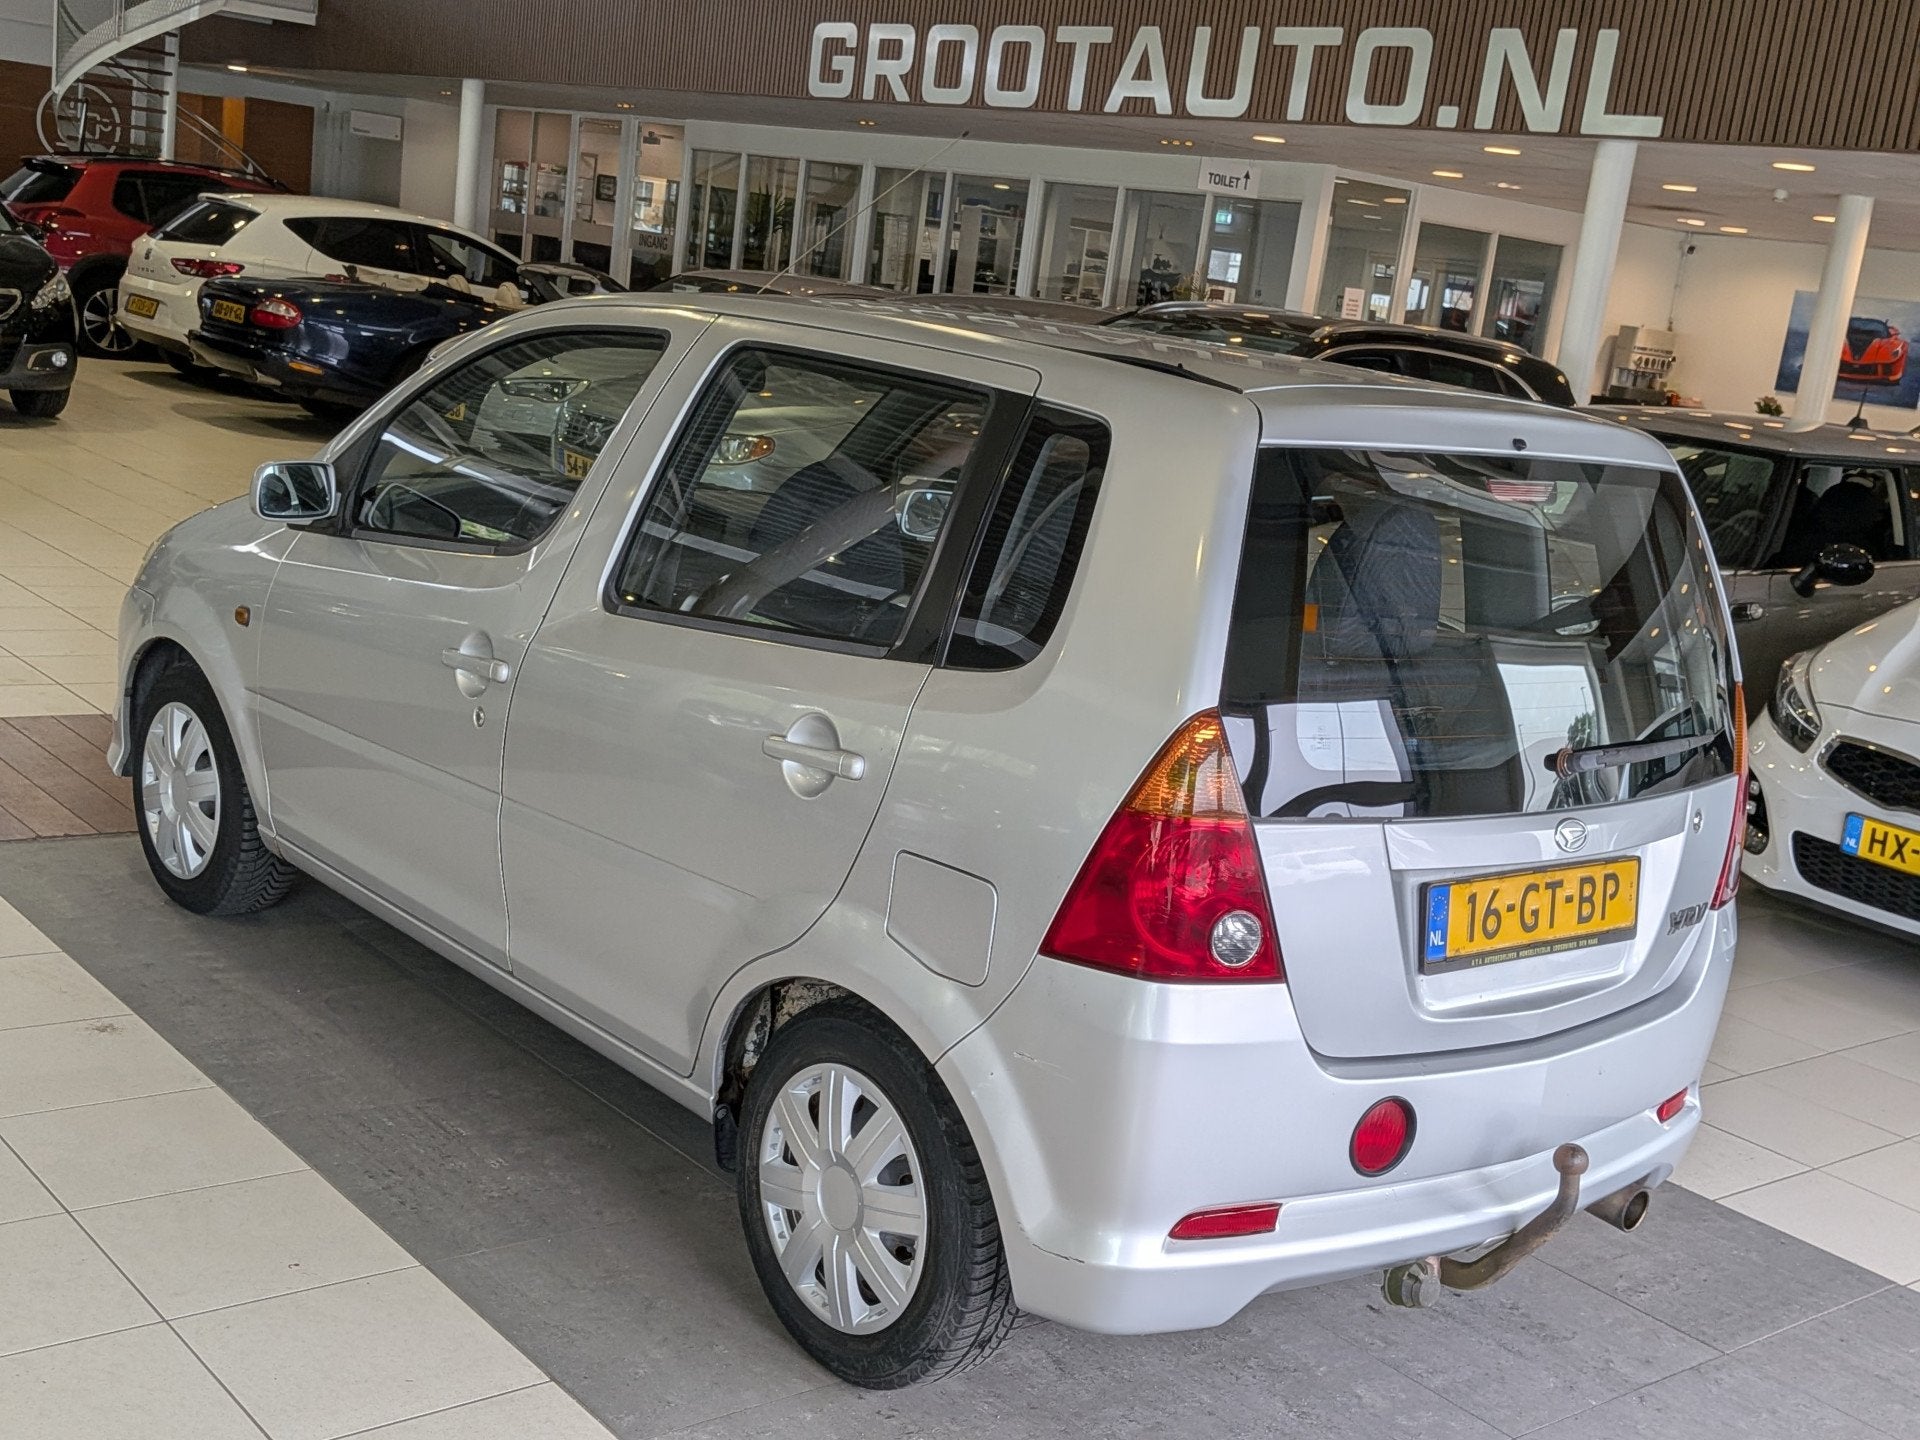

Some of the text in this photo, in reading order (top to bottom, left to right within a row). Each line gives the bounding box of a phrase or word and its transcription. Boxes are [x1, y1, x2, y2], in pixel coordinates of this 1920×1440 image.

[808, 22, 1664, 137] GROOTAUTO.NL
[1208, 172, 1241, 189] TOILET
[638, 233, 668, 251] INGANG
[1845, 837, 1858, 849] NL
[1465, 872, 1620, 943] 16-GT-BP
[1429, 930, 1445, 948] NL
